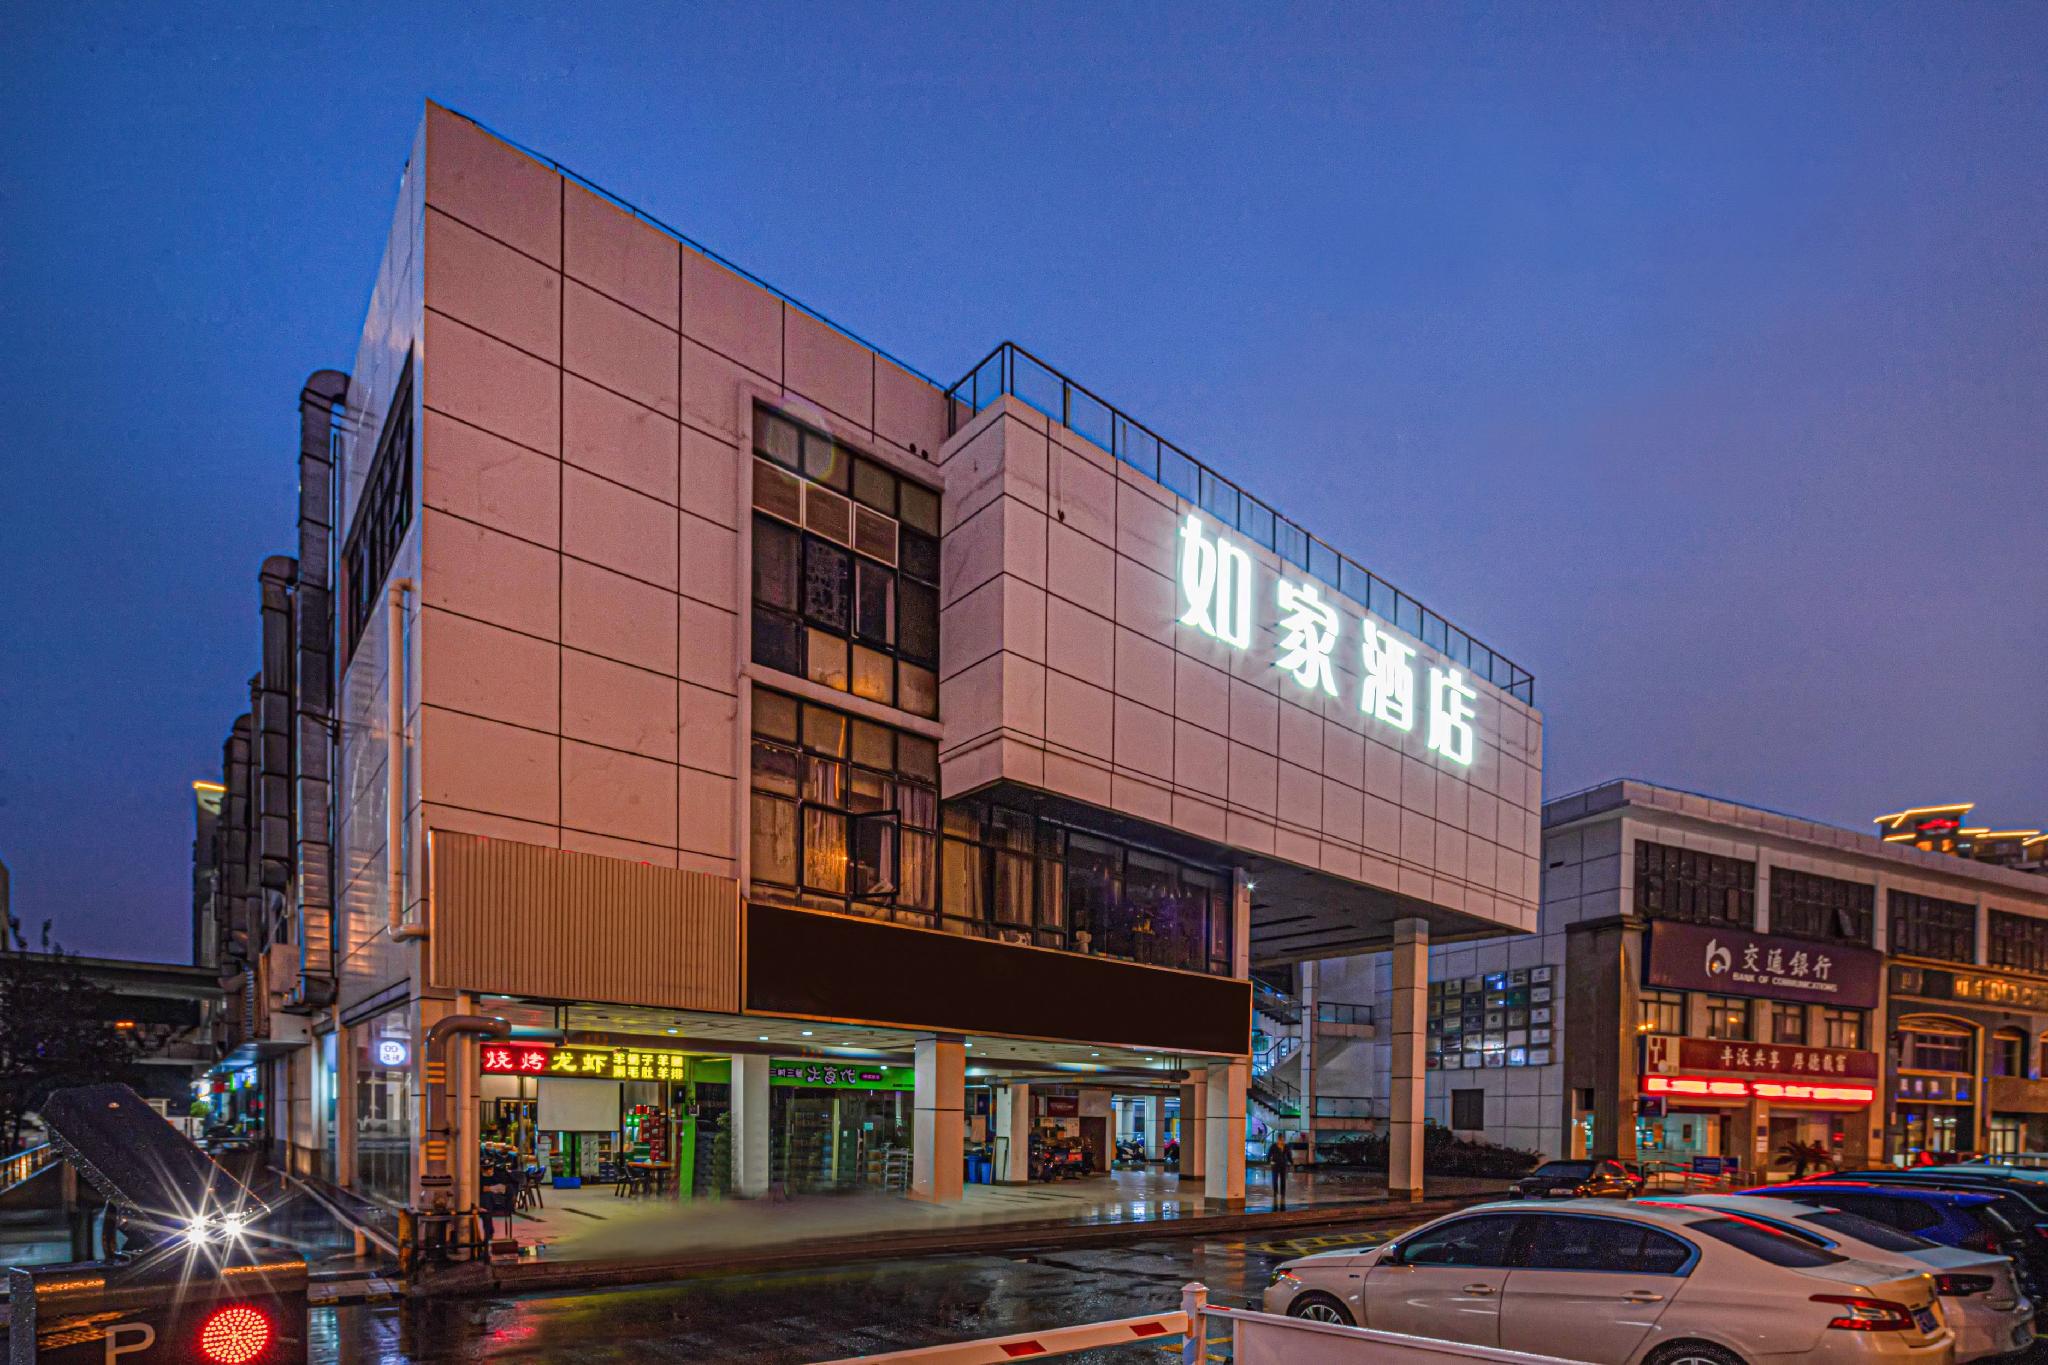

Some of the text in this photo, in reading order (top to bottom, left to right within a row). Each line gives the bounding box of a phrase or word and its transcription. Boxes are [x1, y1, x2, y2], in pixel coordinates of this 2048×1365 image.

[1180, 514, 1477, 766] 如家酒店
[1732, 972, 1755, 983] BANK
[1758, 975, 1769, 984] OF
[105, 1322, 156, 1365] P
